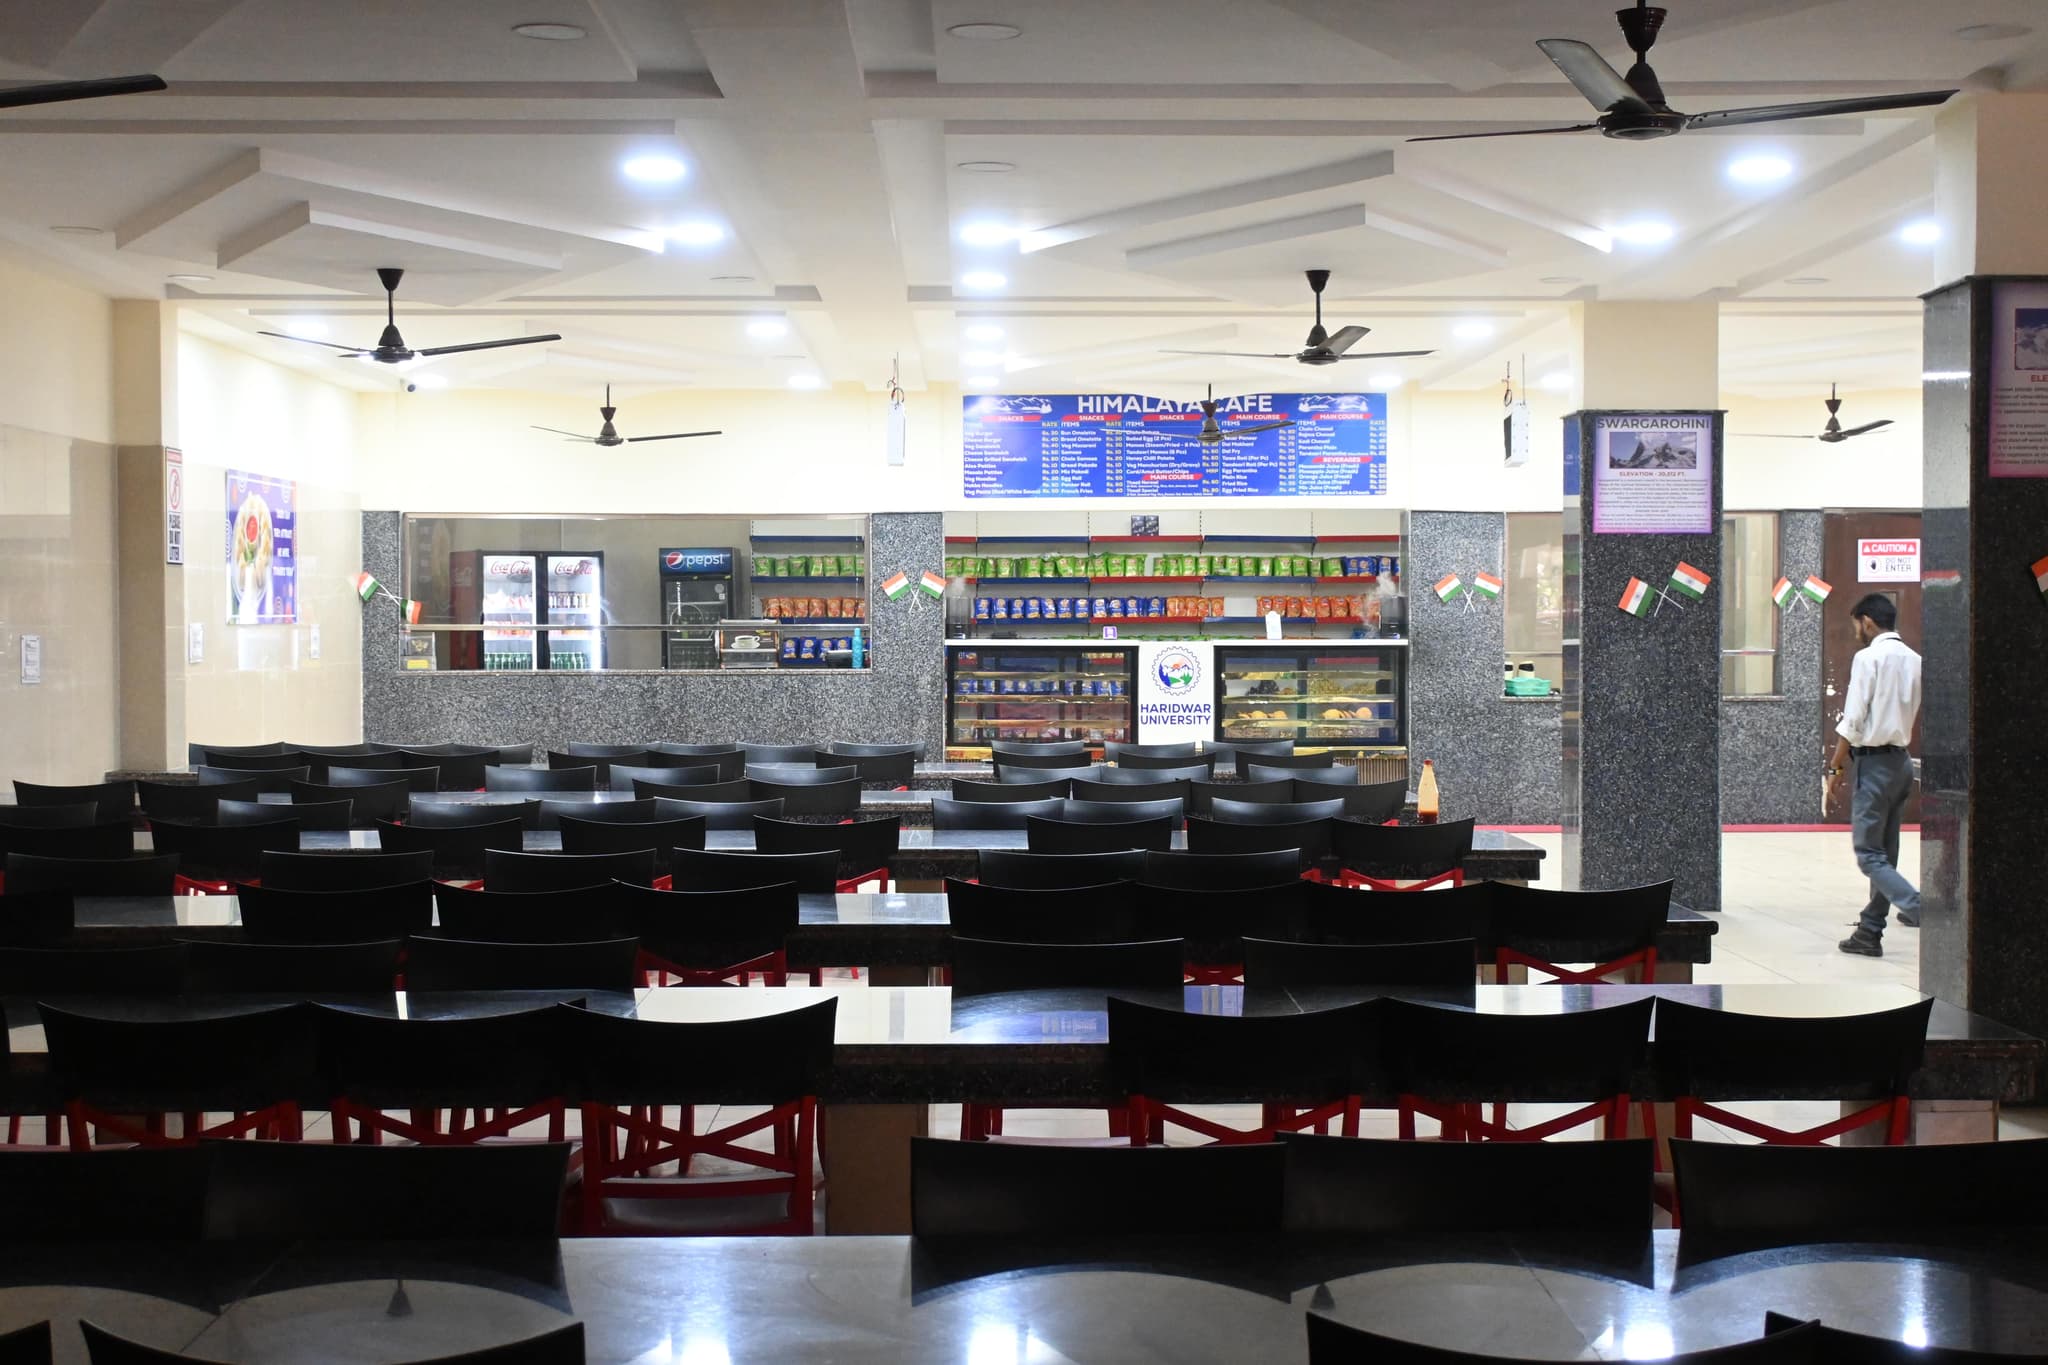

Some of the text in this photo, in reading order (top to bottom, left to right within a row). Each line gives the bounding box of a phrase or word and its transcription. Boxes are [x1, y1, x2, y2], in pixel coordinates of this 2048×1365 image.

[1078, 395, 1204, 412] HIMALAYA
[1597, 418, 1710, 429] SWARGAROHINI
[1871, 544, 1907, 552] CAUTION
[686, 554, 724, 569] pepsi
[1886, 564, 1912, 572] ENTER
[1140, 704, 1211, 713] HARIDWAR
[1140, 715, 1211, 725] UNIVERSITY
